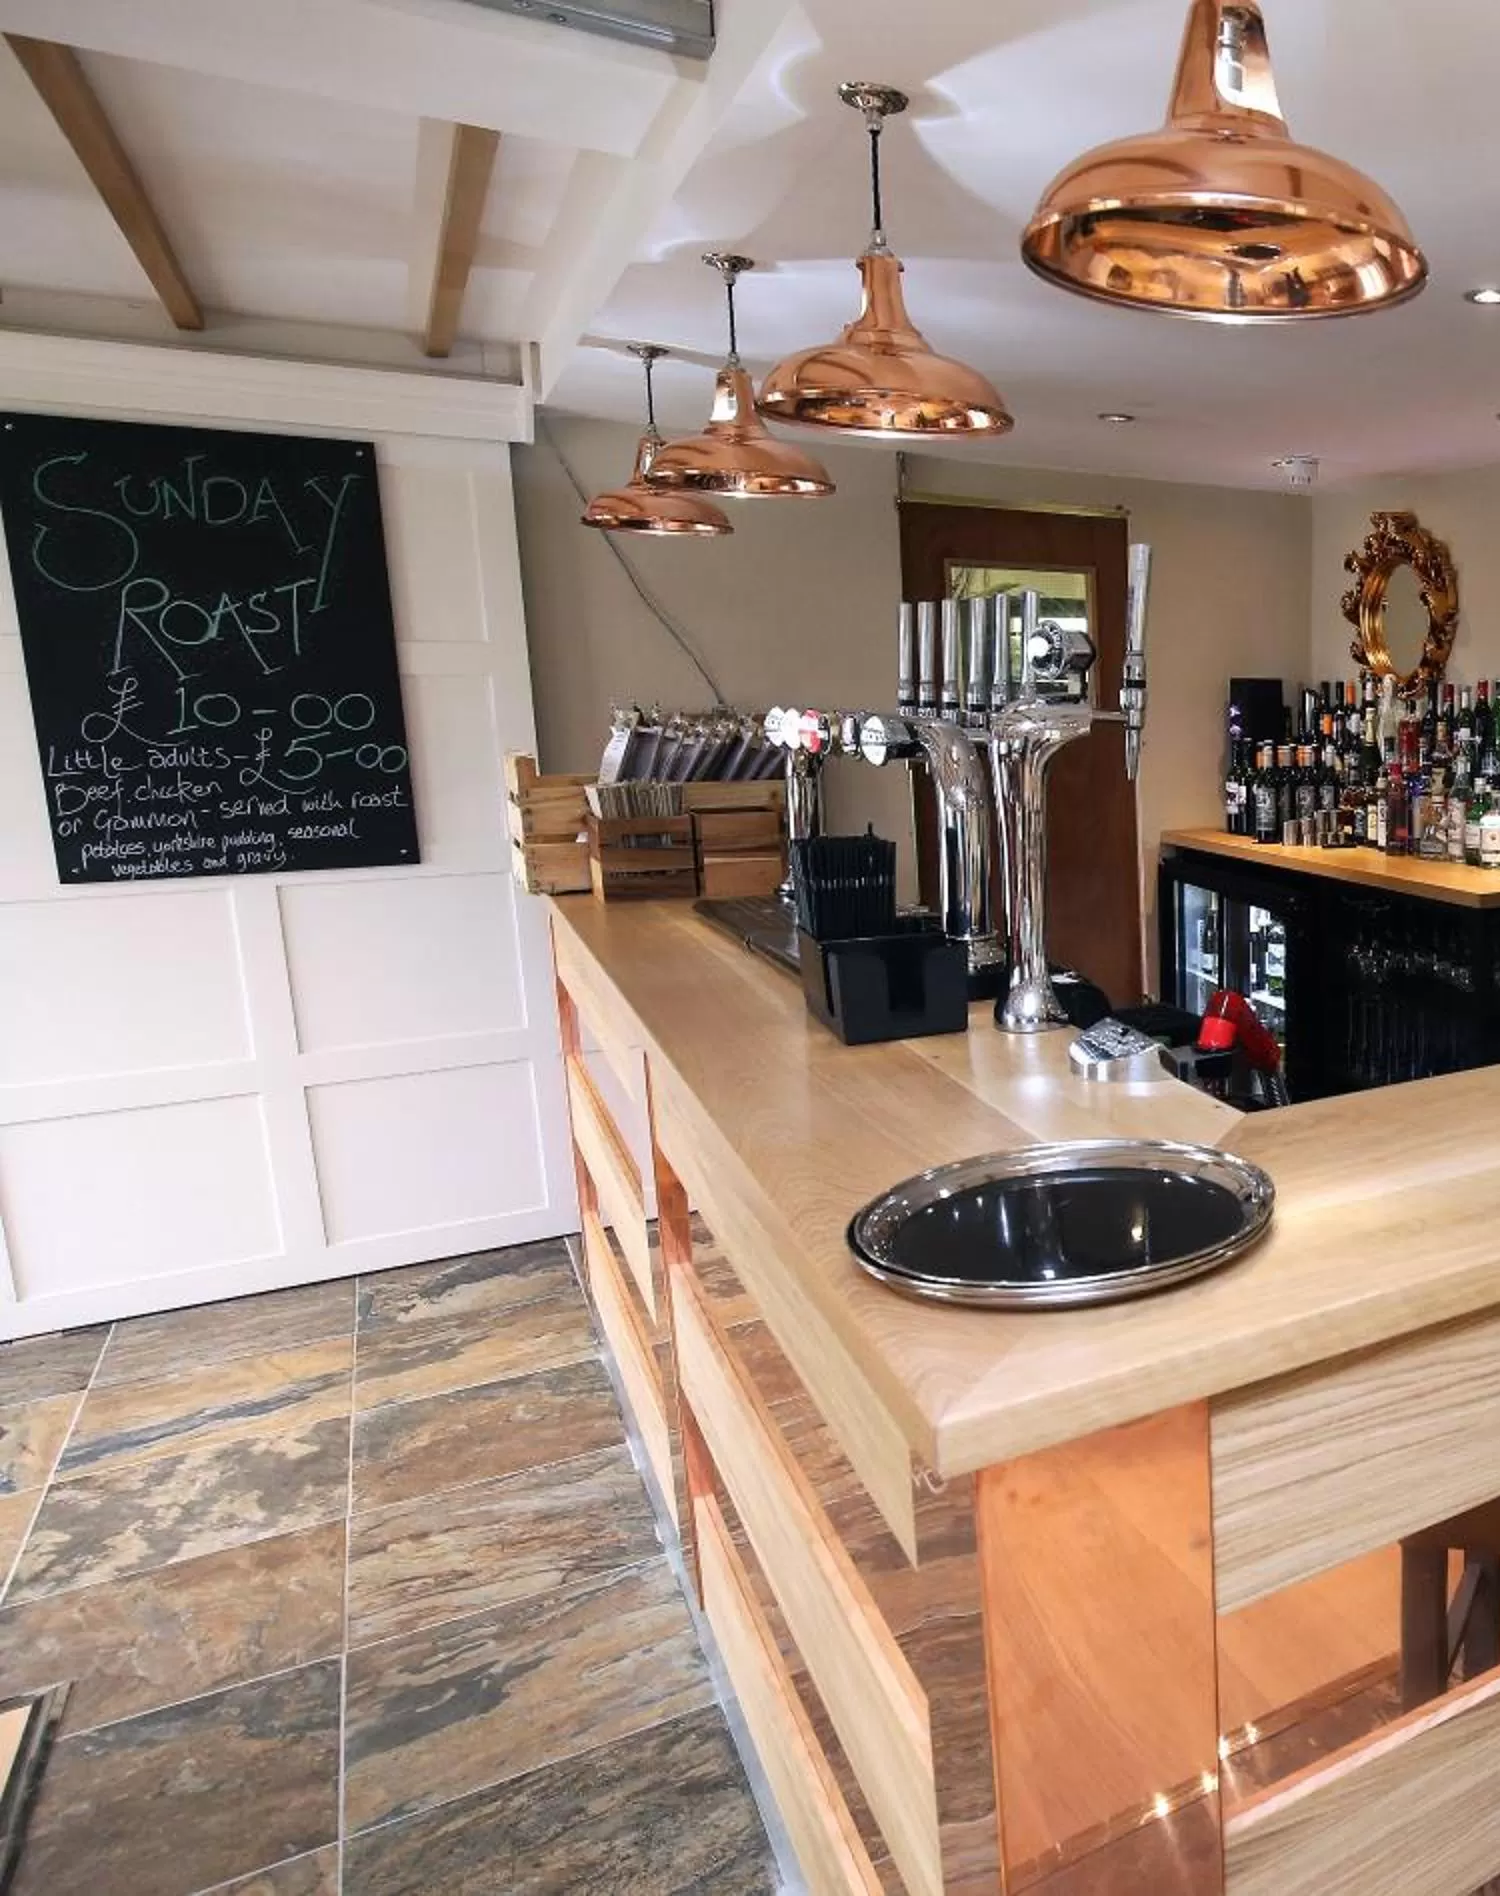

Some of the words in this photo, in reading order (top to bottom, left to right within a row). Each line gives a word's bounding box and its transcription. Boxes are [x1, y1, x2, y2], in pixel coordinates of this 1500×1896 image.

[33, 452, 362, 613] SUNDAY
[105, 577, 318, 681] ROAST
[47, 745, 143, 779] Little
[135, 771, 222, 803] chicken
[58, 817, 83, 836] or
[220, 794, 291, 818] served
[302, 789, 343, 812] with
[352, 785, 408, 808] roast
[288, 817, 361, 839] seasonal
[111, 854, 194, 880] vegetables
[202, 855, 228, 869] and
